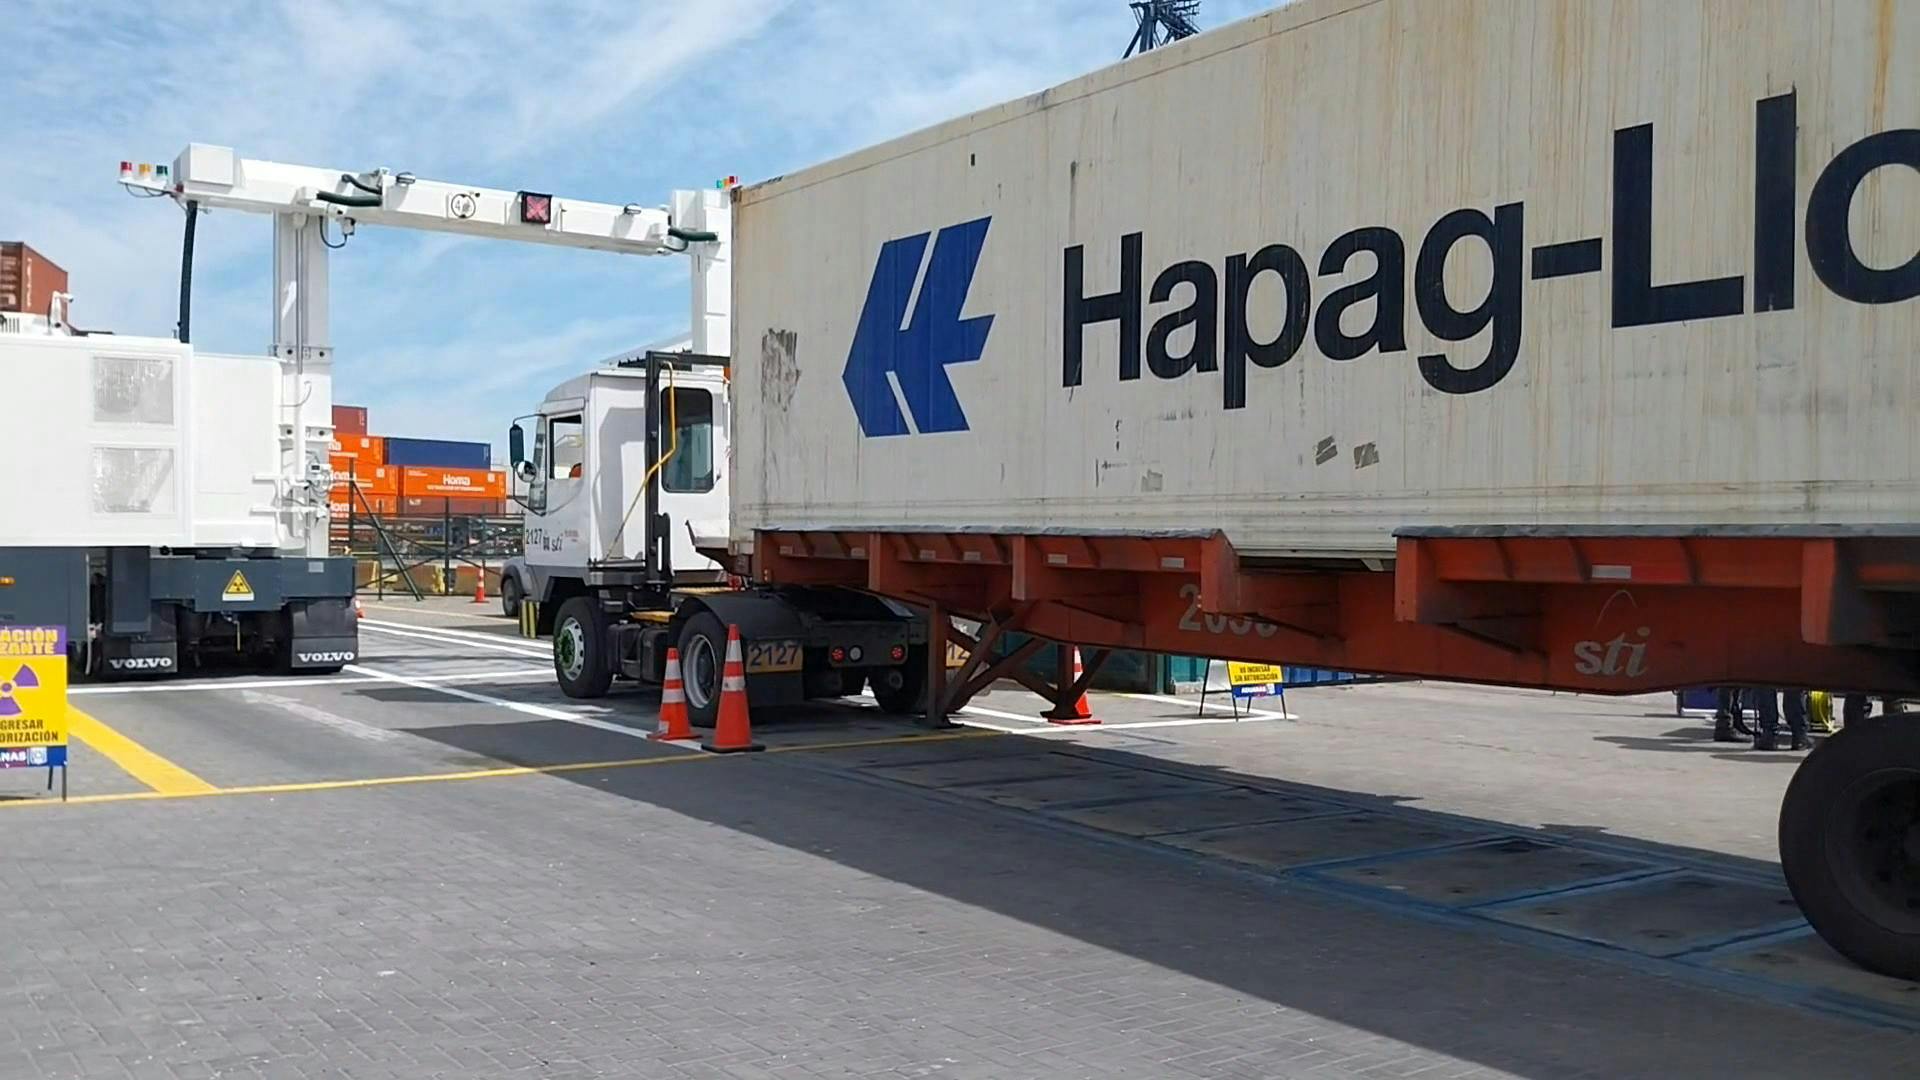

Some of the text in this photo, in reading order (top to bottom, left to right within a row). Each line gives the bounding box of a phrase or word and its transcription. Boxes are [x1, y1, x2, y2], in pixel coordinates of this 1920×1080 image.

[442, 473, 471, 486] Homa
[525, 527, 543, 545] 2127
[298, 652, 354, 663] VOLVO
[750, 644, 799, 666] 2127
[1574, 627, 1650, 676] sti
[110, 657, 172, 668] VOLVO
[0, 750, 27, 762] NAS
